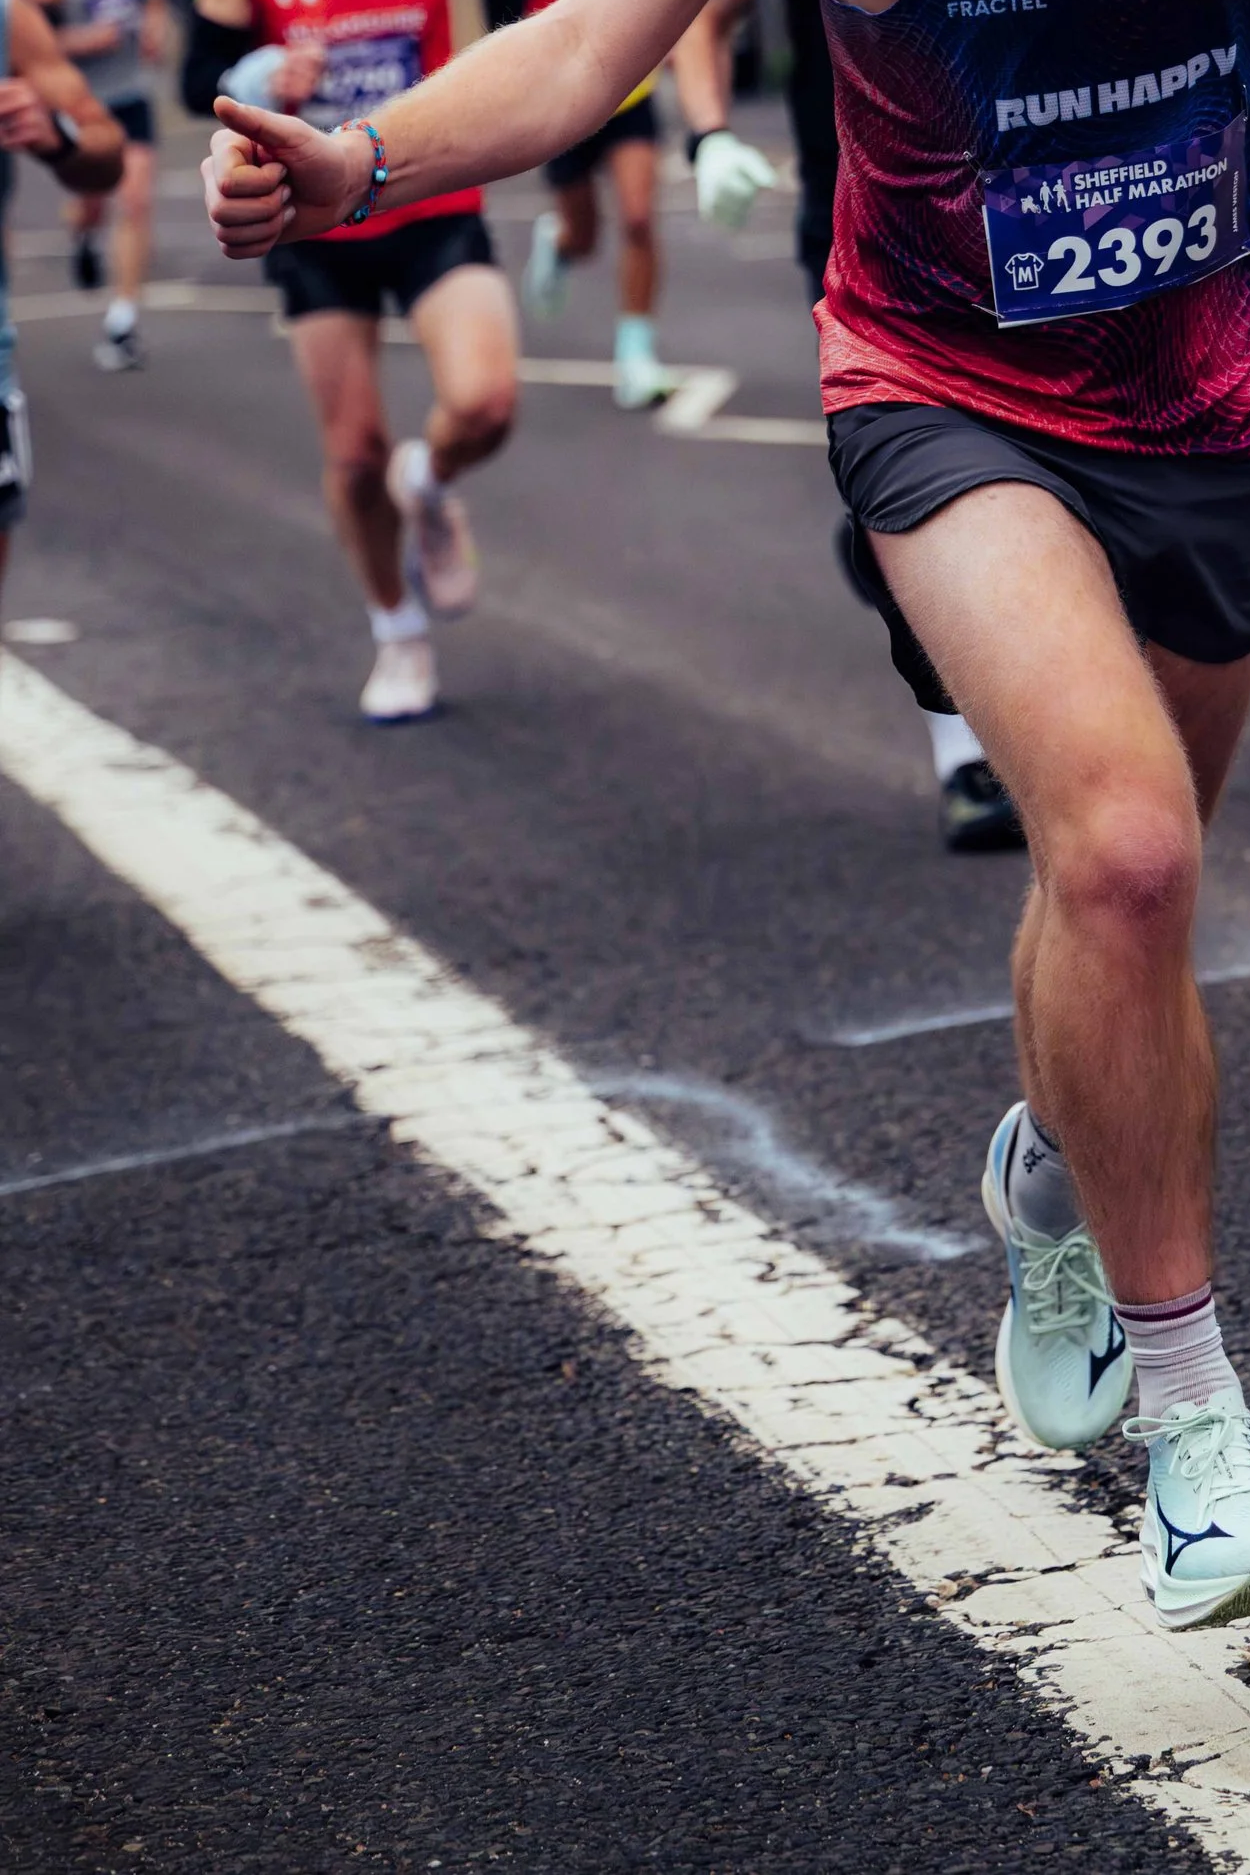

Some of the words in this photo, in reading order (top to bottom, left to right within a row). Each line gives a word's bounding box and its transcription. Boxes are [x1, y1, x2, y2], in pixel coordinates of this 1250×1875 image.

[995, 86, 1092, 132] RUN
[1098, 43, 1237, 115] HAPPY
[1073, 159, 1167, 191] SHEFFIELD
[1075, 188, 1123, 210] HALF
[1128, 157, 1228, 201] MARATHON
[1018, 265, 1034, 283] M
[1047, 204, 1217, 295] 2393
